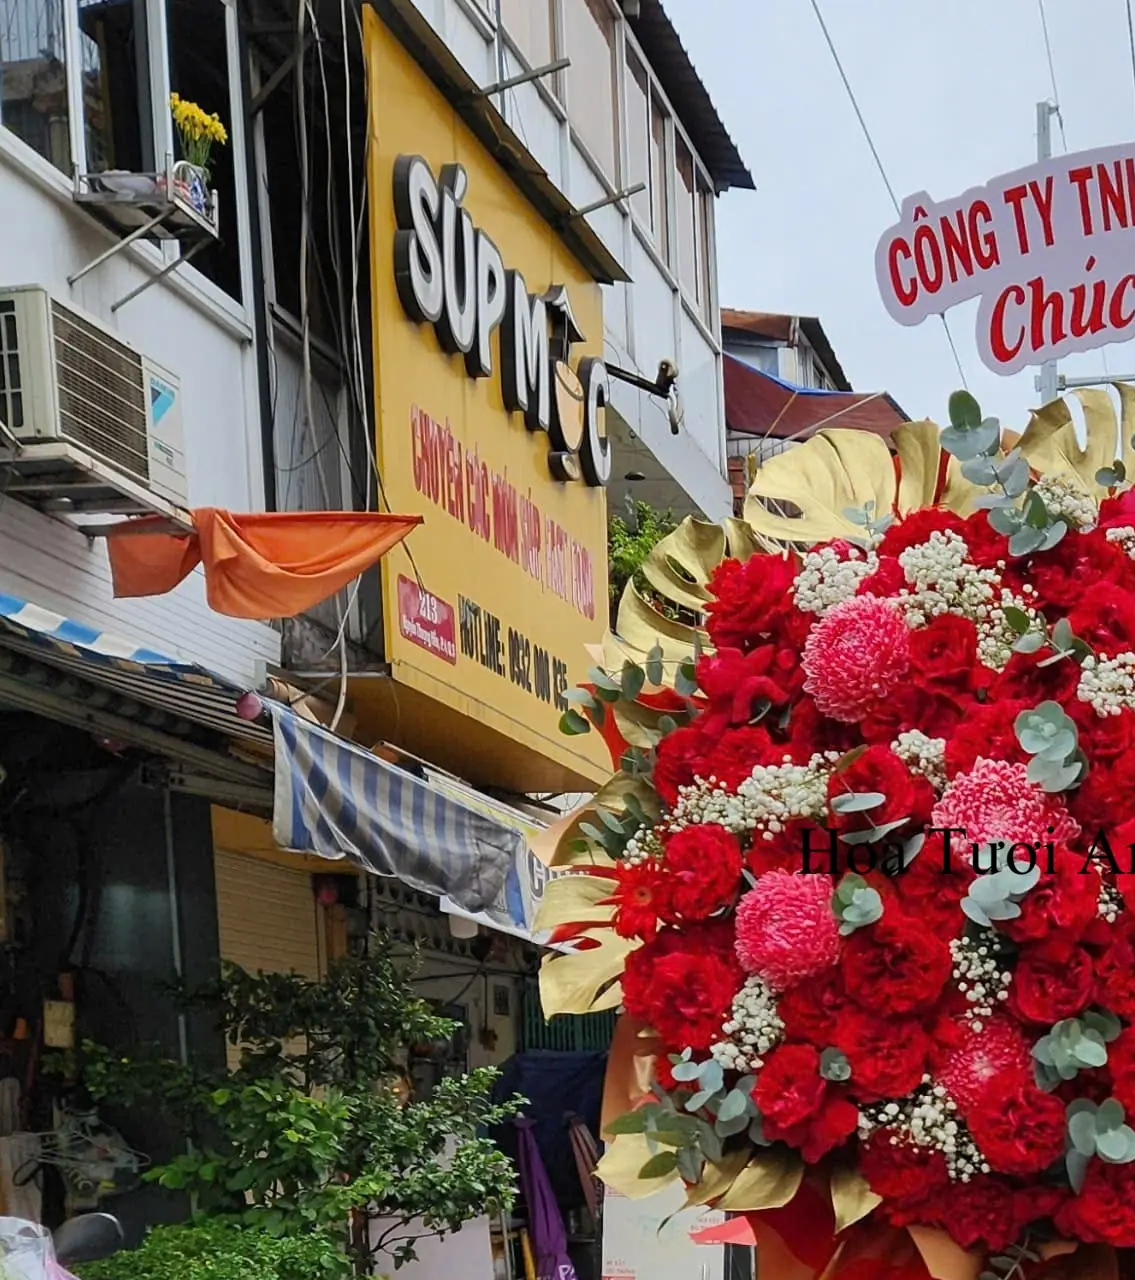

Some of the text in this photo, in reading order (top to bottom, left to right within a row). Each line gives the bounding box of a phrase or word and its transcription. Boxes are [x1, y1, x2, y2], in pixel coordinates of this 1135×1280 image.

[393, 154, 506, 378] SÚP
[888, 206, 1000, 306] CÔNG
[1003, 175, 1056, 255] TY
[466, 441, 491, 542] CÁC
[458, 593, 505, 678] HOTLINE:
